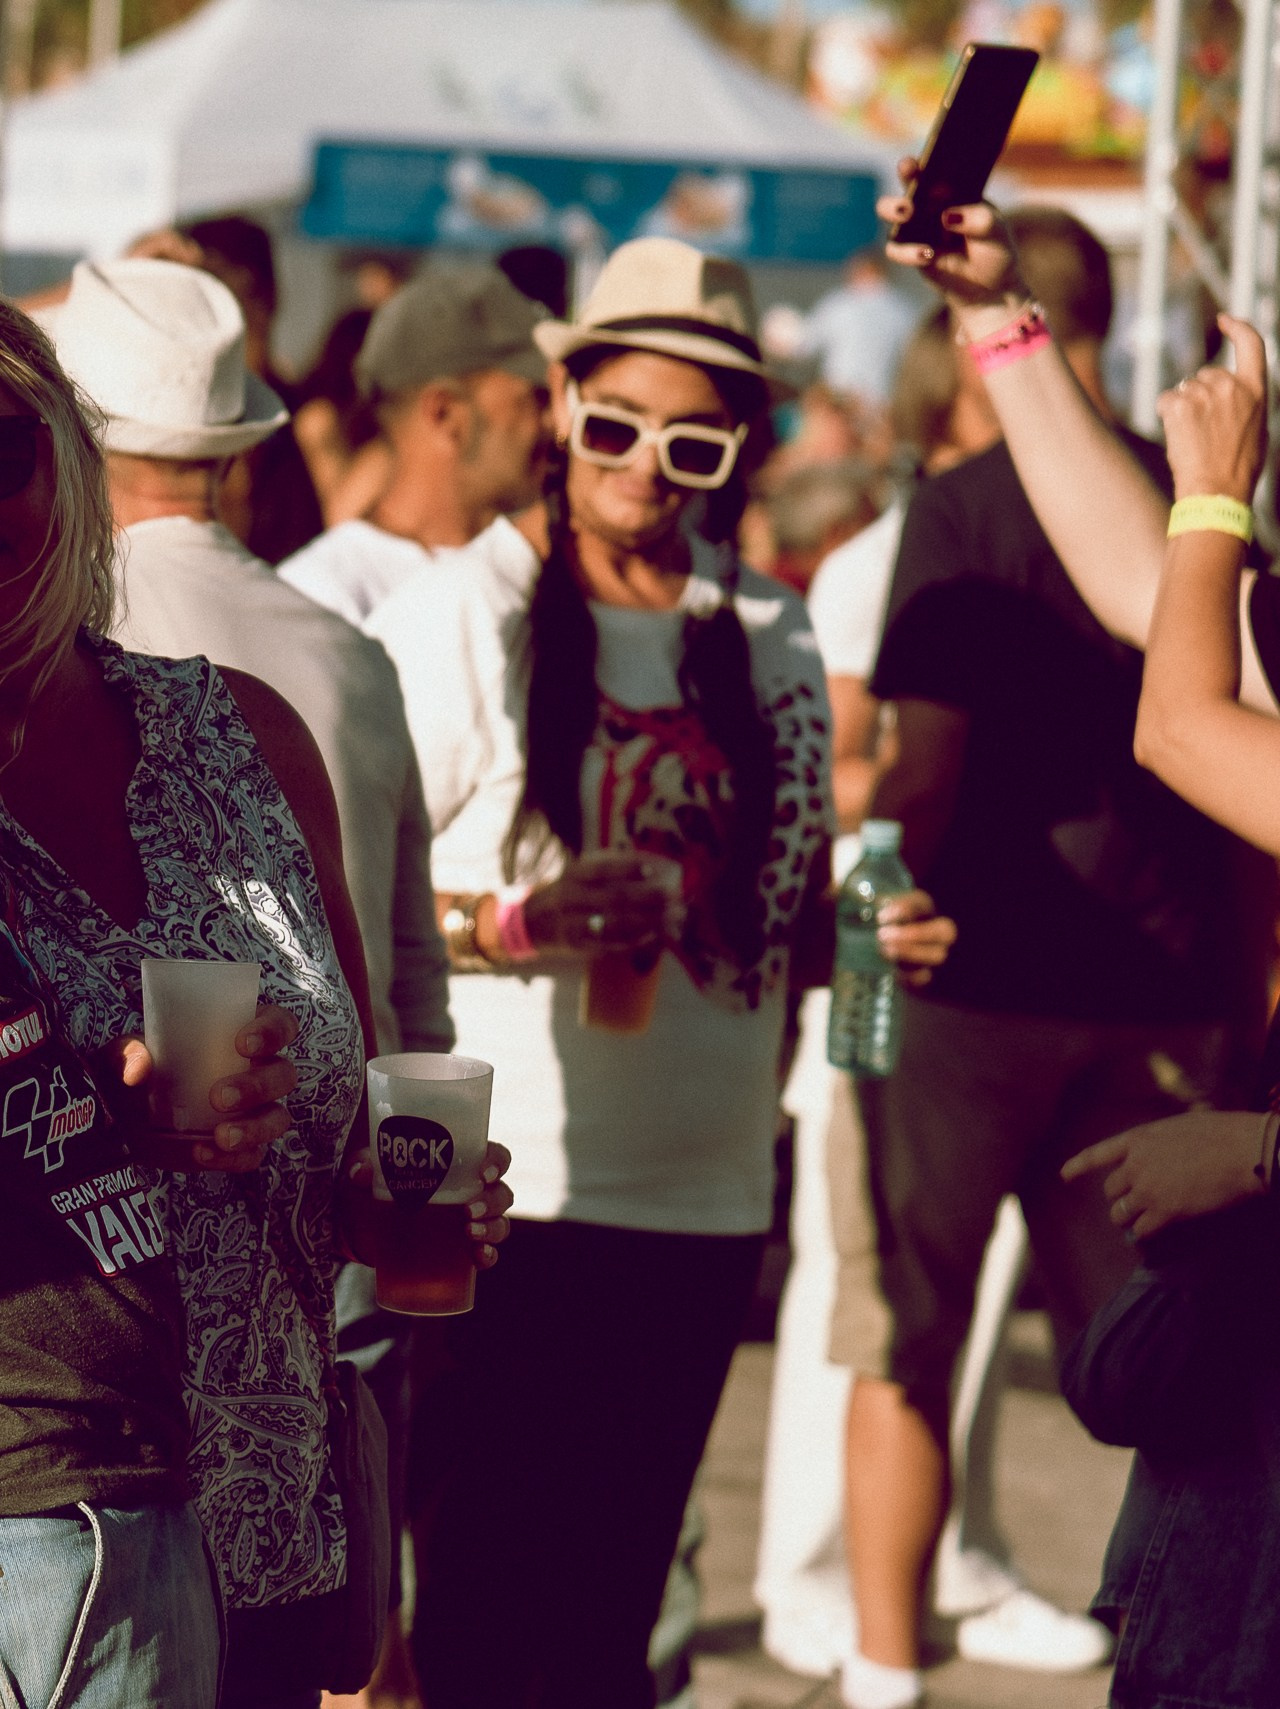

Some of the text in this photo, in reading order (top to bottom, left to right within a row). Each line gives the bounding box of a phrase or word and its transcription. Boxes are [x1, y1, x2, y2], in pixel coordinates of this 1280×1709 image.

[379, 1131, 450, 1170] ROCK
[50, 1166, 137, 1214] GRAN PRMIO
